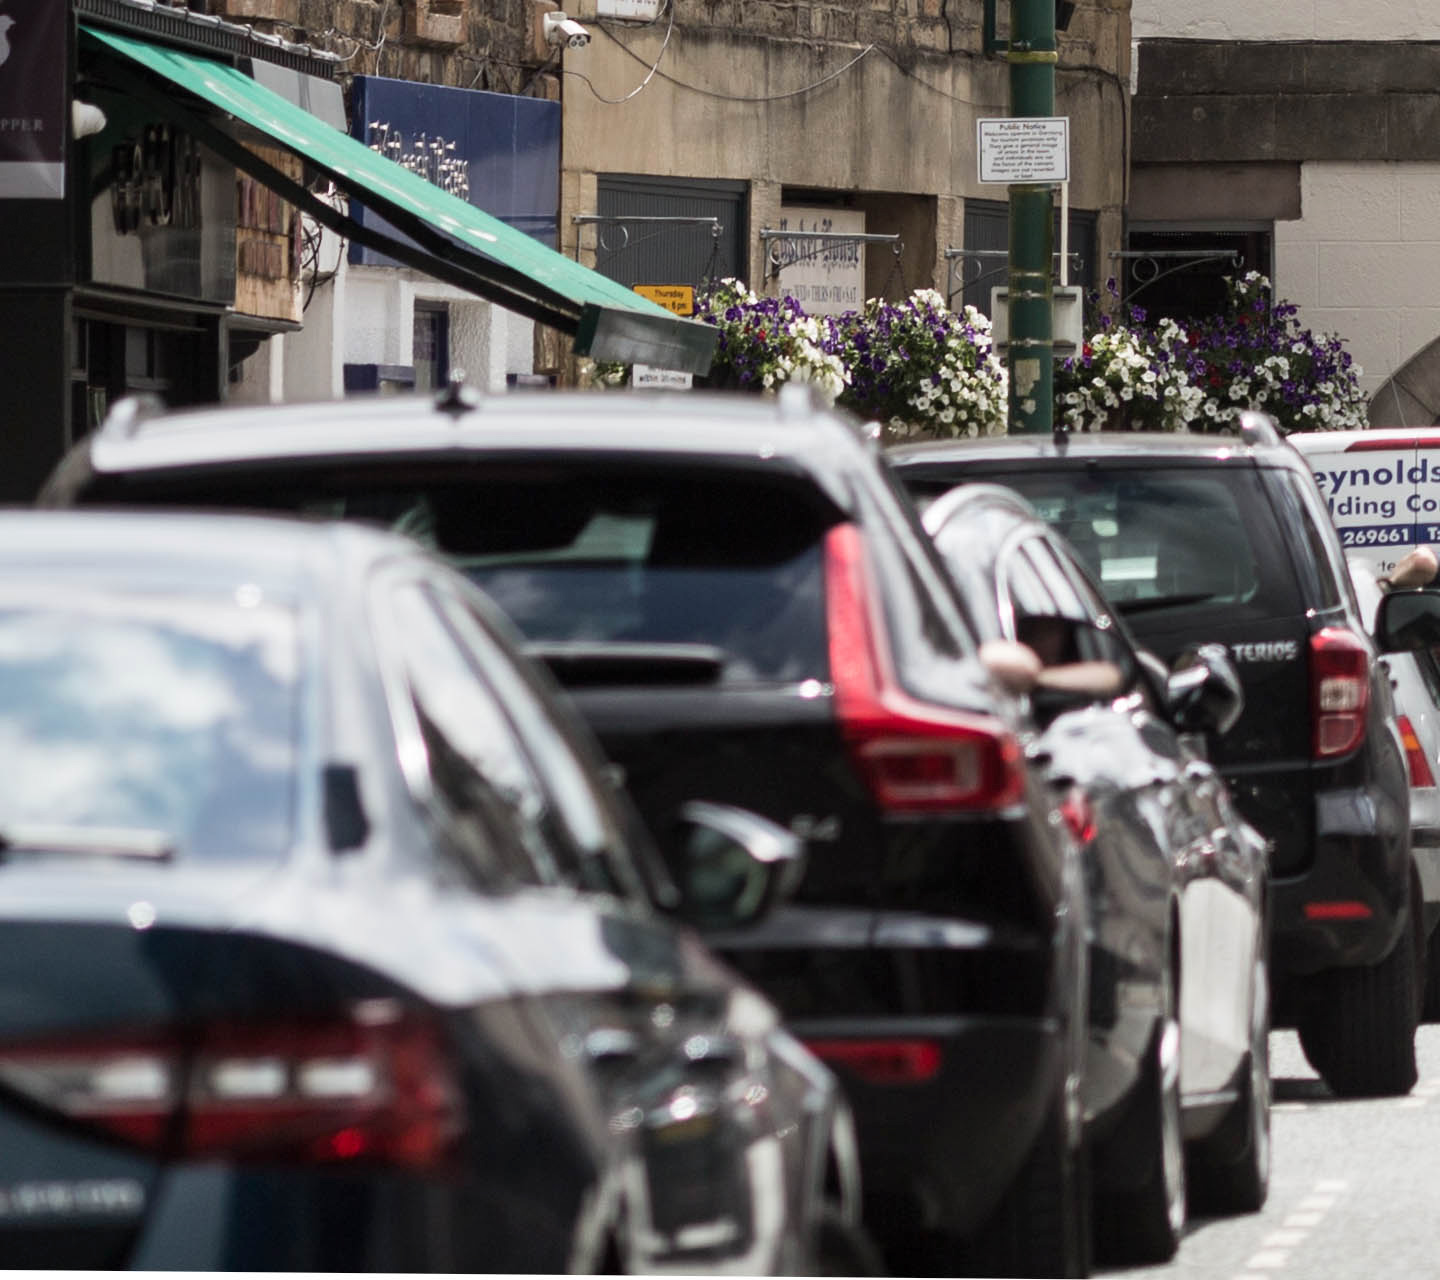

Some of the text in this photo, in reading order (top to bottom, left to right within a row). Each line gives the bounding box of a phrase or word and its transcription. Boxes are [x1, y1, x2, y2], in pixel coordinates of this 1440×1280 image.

[654, 289, 684, 299] Thursday
[1327, 493, 1397, 519] lding
[1343, 527, 1410, 546] 269661
[1231, 640, 1297, 662] TERIOS
